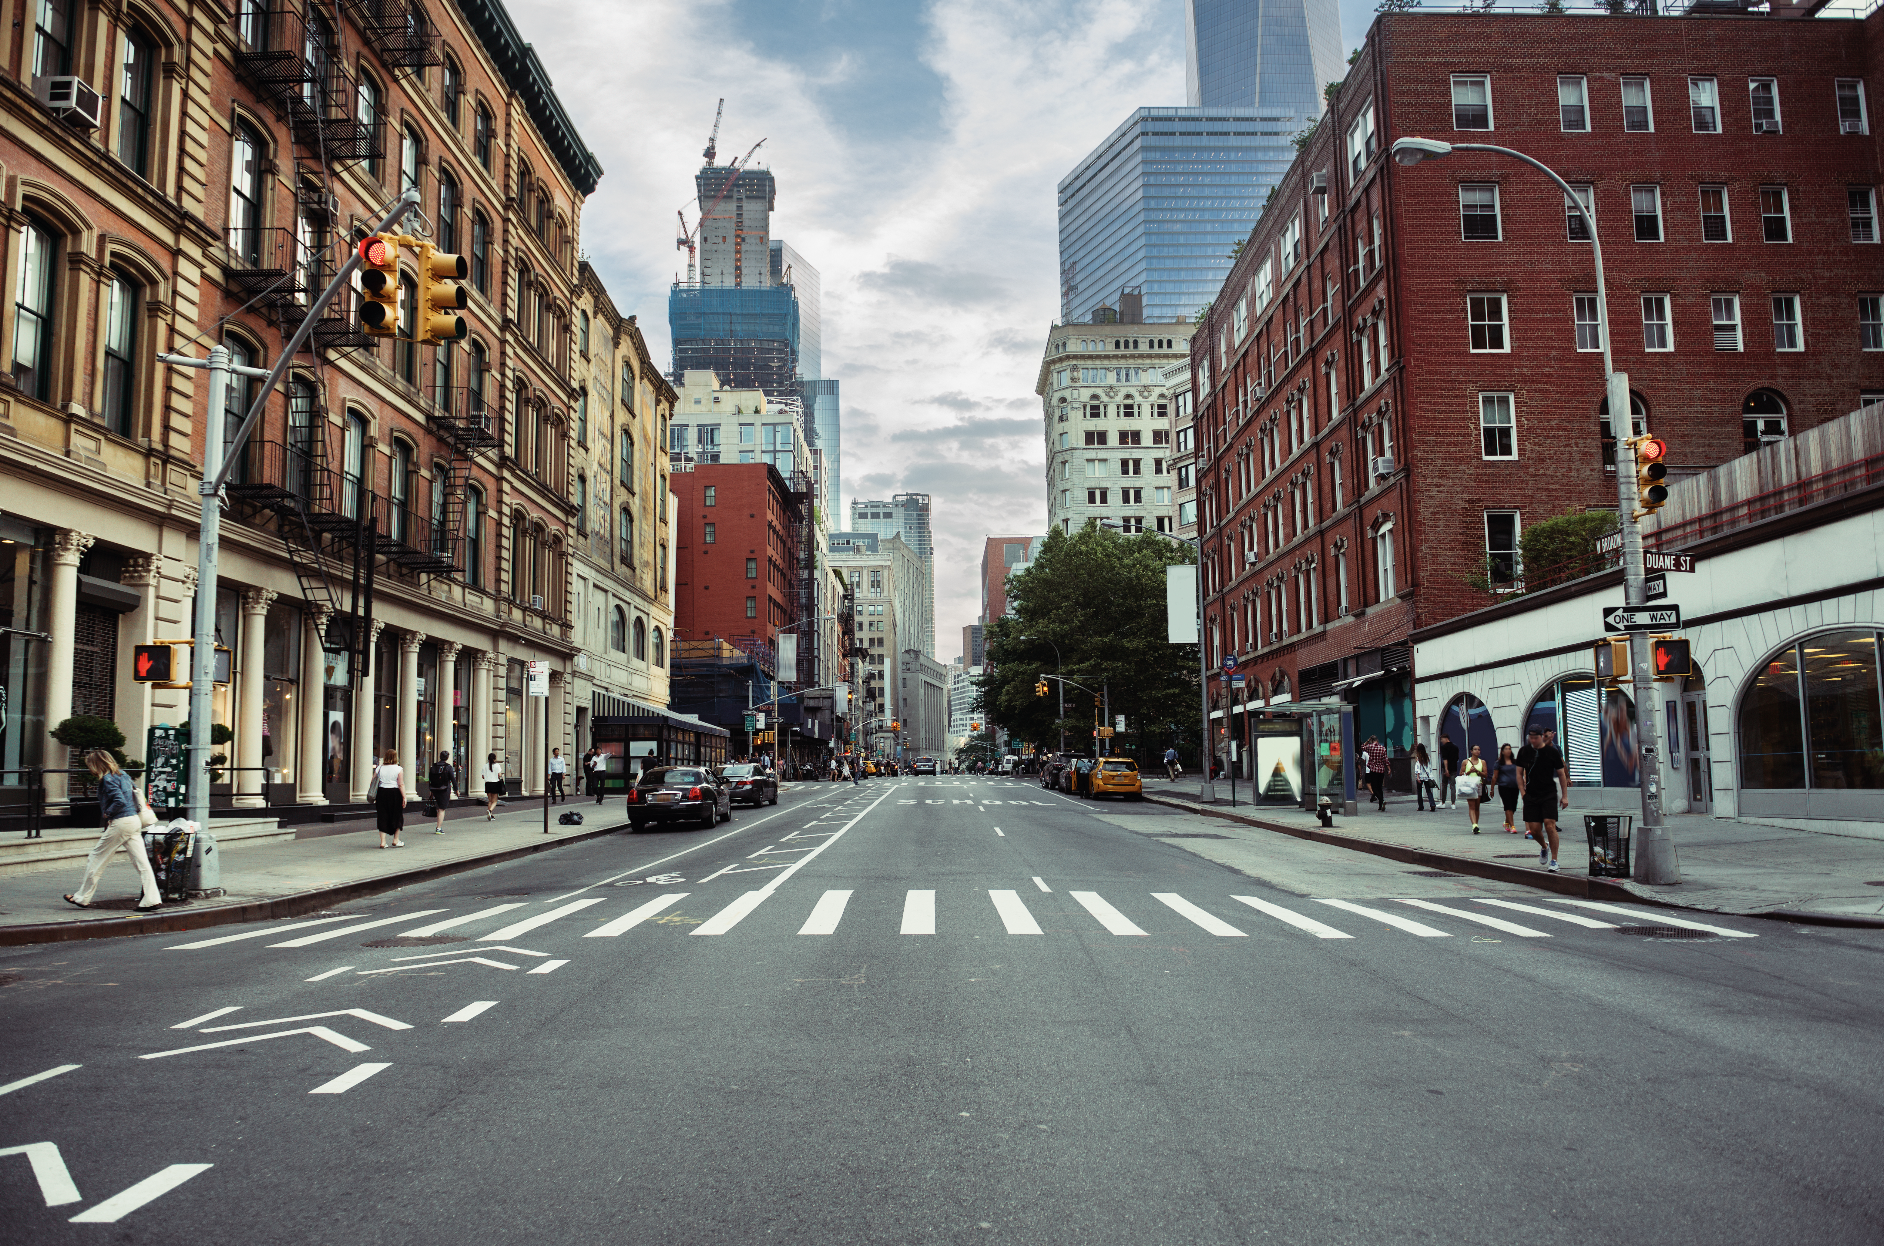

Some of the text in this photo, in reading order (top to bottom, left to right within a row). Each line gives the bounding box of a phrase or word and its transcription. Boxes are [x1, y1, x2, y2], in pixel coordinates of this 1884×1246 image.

[1646, 553, 1691, 571] DUANE ST
[1646, 581, 1661, 594] WAY
[1613, 611, 1674, 625] ONE WAY
